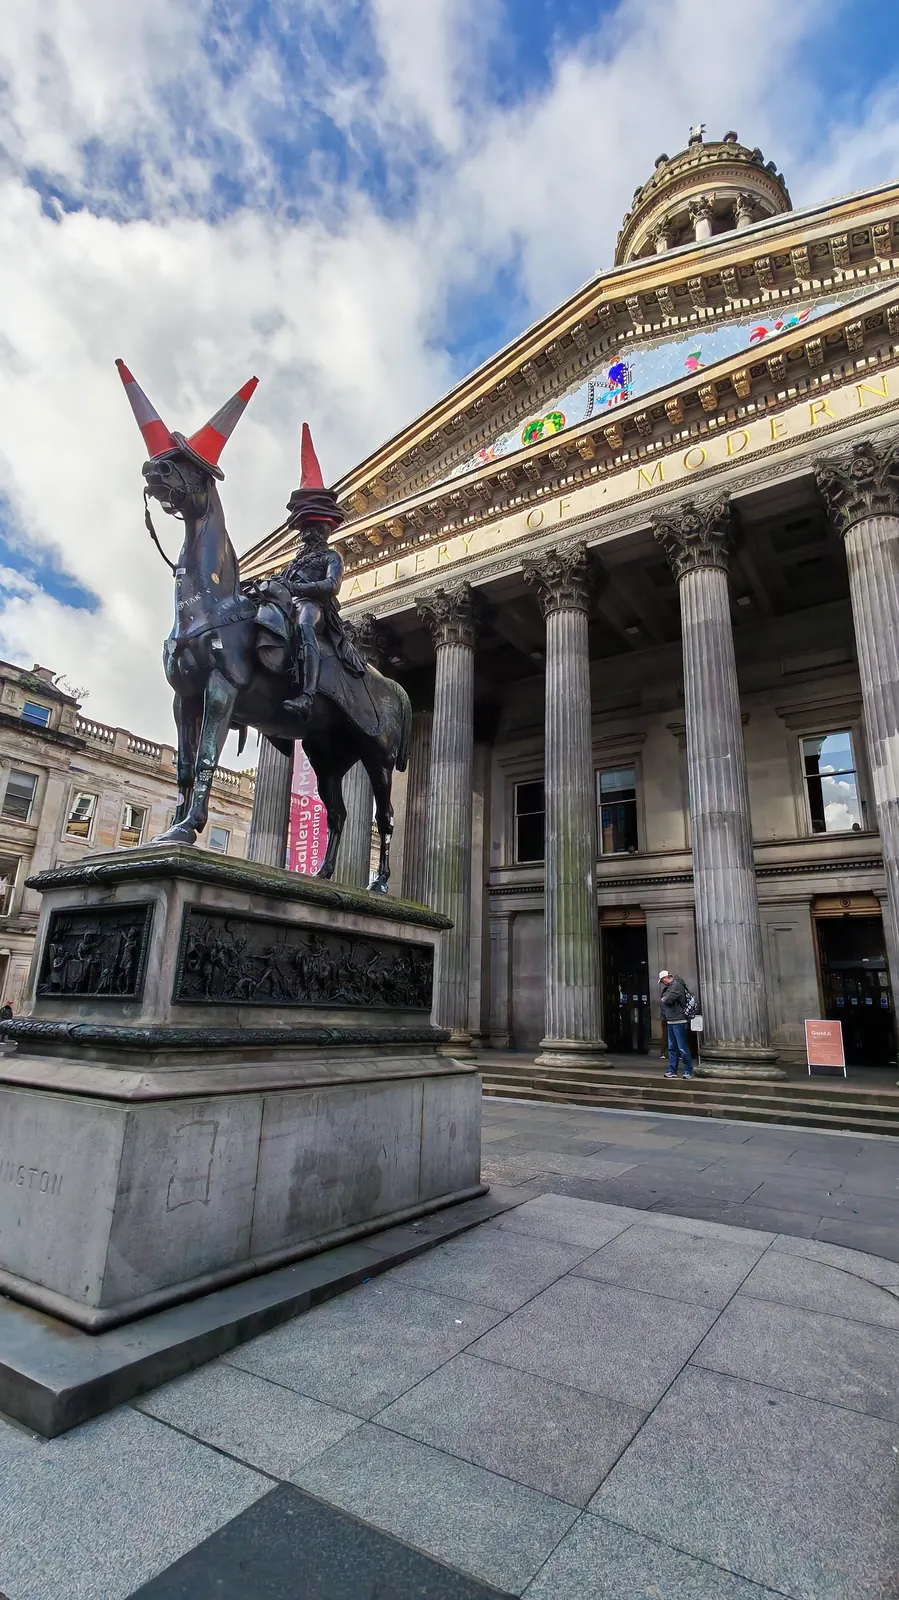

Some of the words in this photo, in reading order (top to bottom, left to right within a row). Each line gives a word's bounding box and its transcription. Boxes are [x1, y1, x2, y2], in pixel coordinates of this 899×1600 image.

[349, 533, 475, 598] ALLERY
[526, 496, 571, 529] OF
[637, 375, 889, 490] MODERN
[298, 790, 309, 807] of
[296, 810, 311, 874] Gallery
[310, 804, 322, 875] Celebrating
